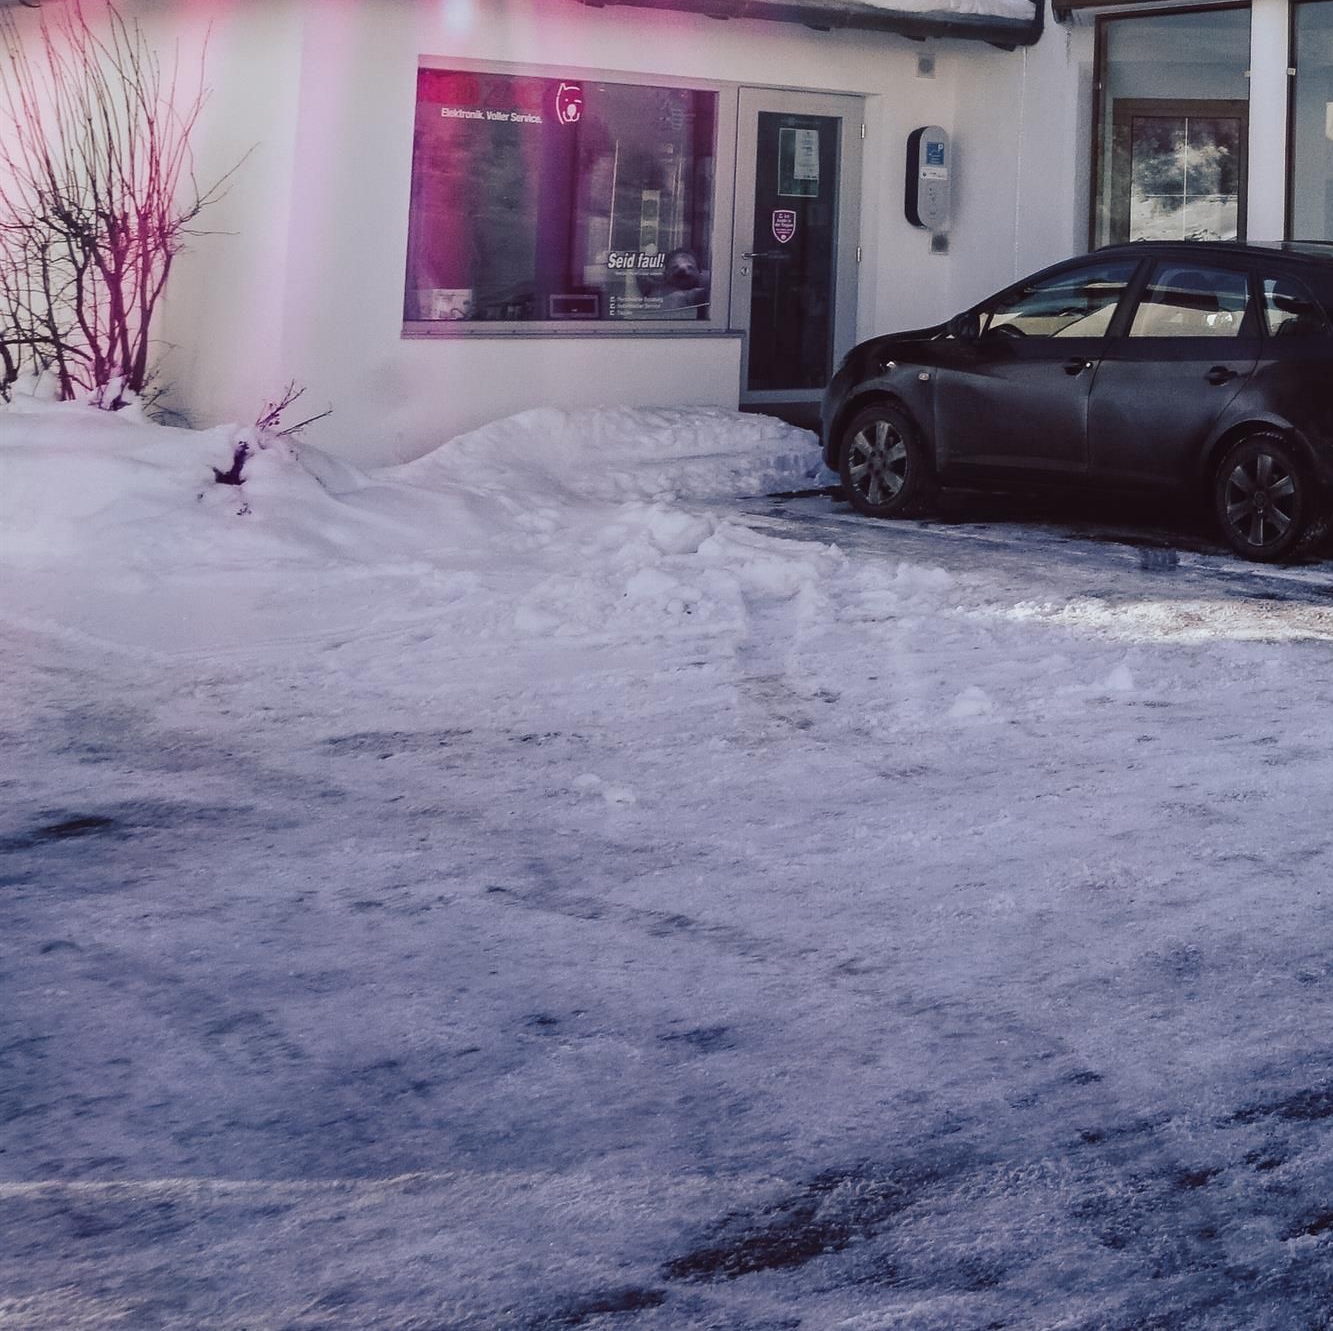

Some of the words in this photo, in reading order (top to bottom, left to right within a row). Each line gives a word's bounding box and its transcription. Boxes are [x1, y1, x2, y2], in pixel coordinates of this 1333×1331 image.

[441, 107, 485, 120] Elektronik.
[486, 110, 509, 122] Voller
[510, 112, 543, 124] Service.
[608, 253, 635, 268] Seid
[637, 253, 665, 268] faul!
